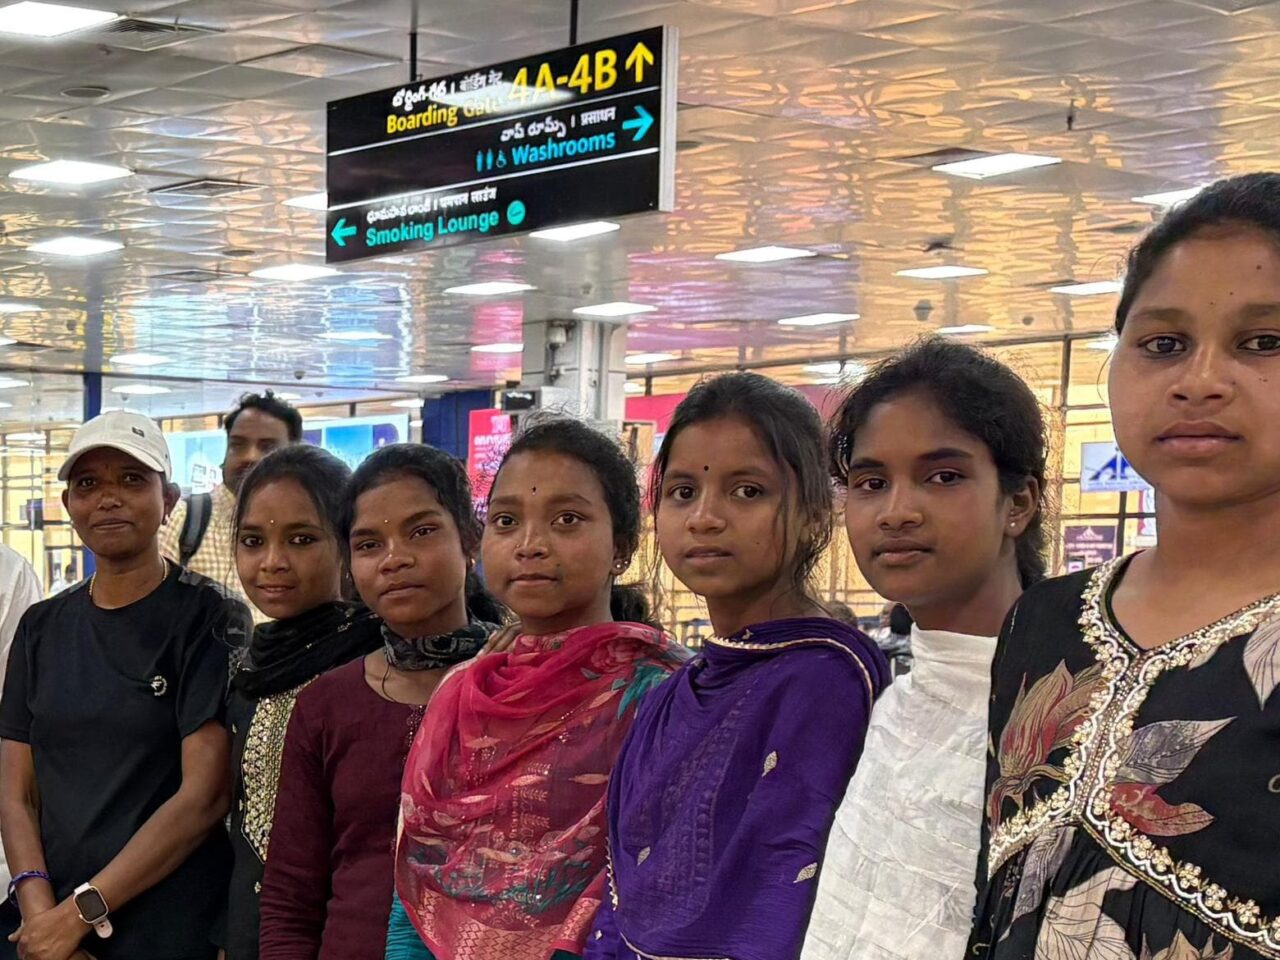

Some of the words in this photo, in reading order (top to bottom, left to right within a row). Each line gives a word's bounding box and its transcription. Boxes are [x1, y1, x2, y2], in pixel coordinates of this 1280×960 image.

[387, 104, 458, 133] Boarding
[509, 49, 617, 104] 4A-4B
[512, 132, 616, 165] Washrooms
[365, 221, 435, 247] Smoking
[437, 211, 500, 234] Lounge
